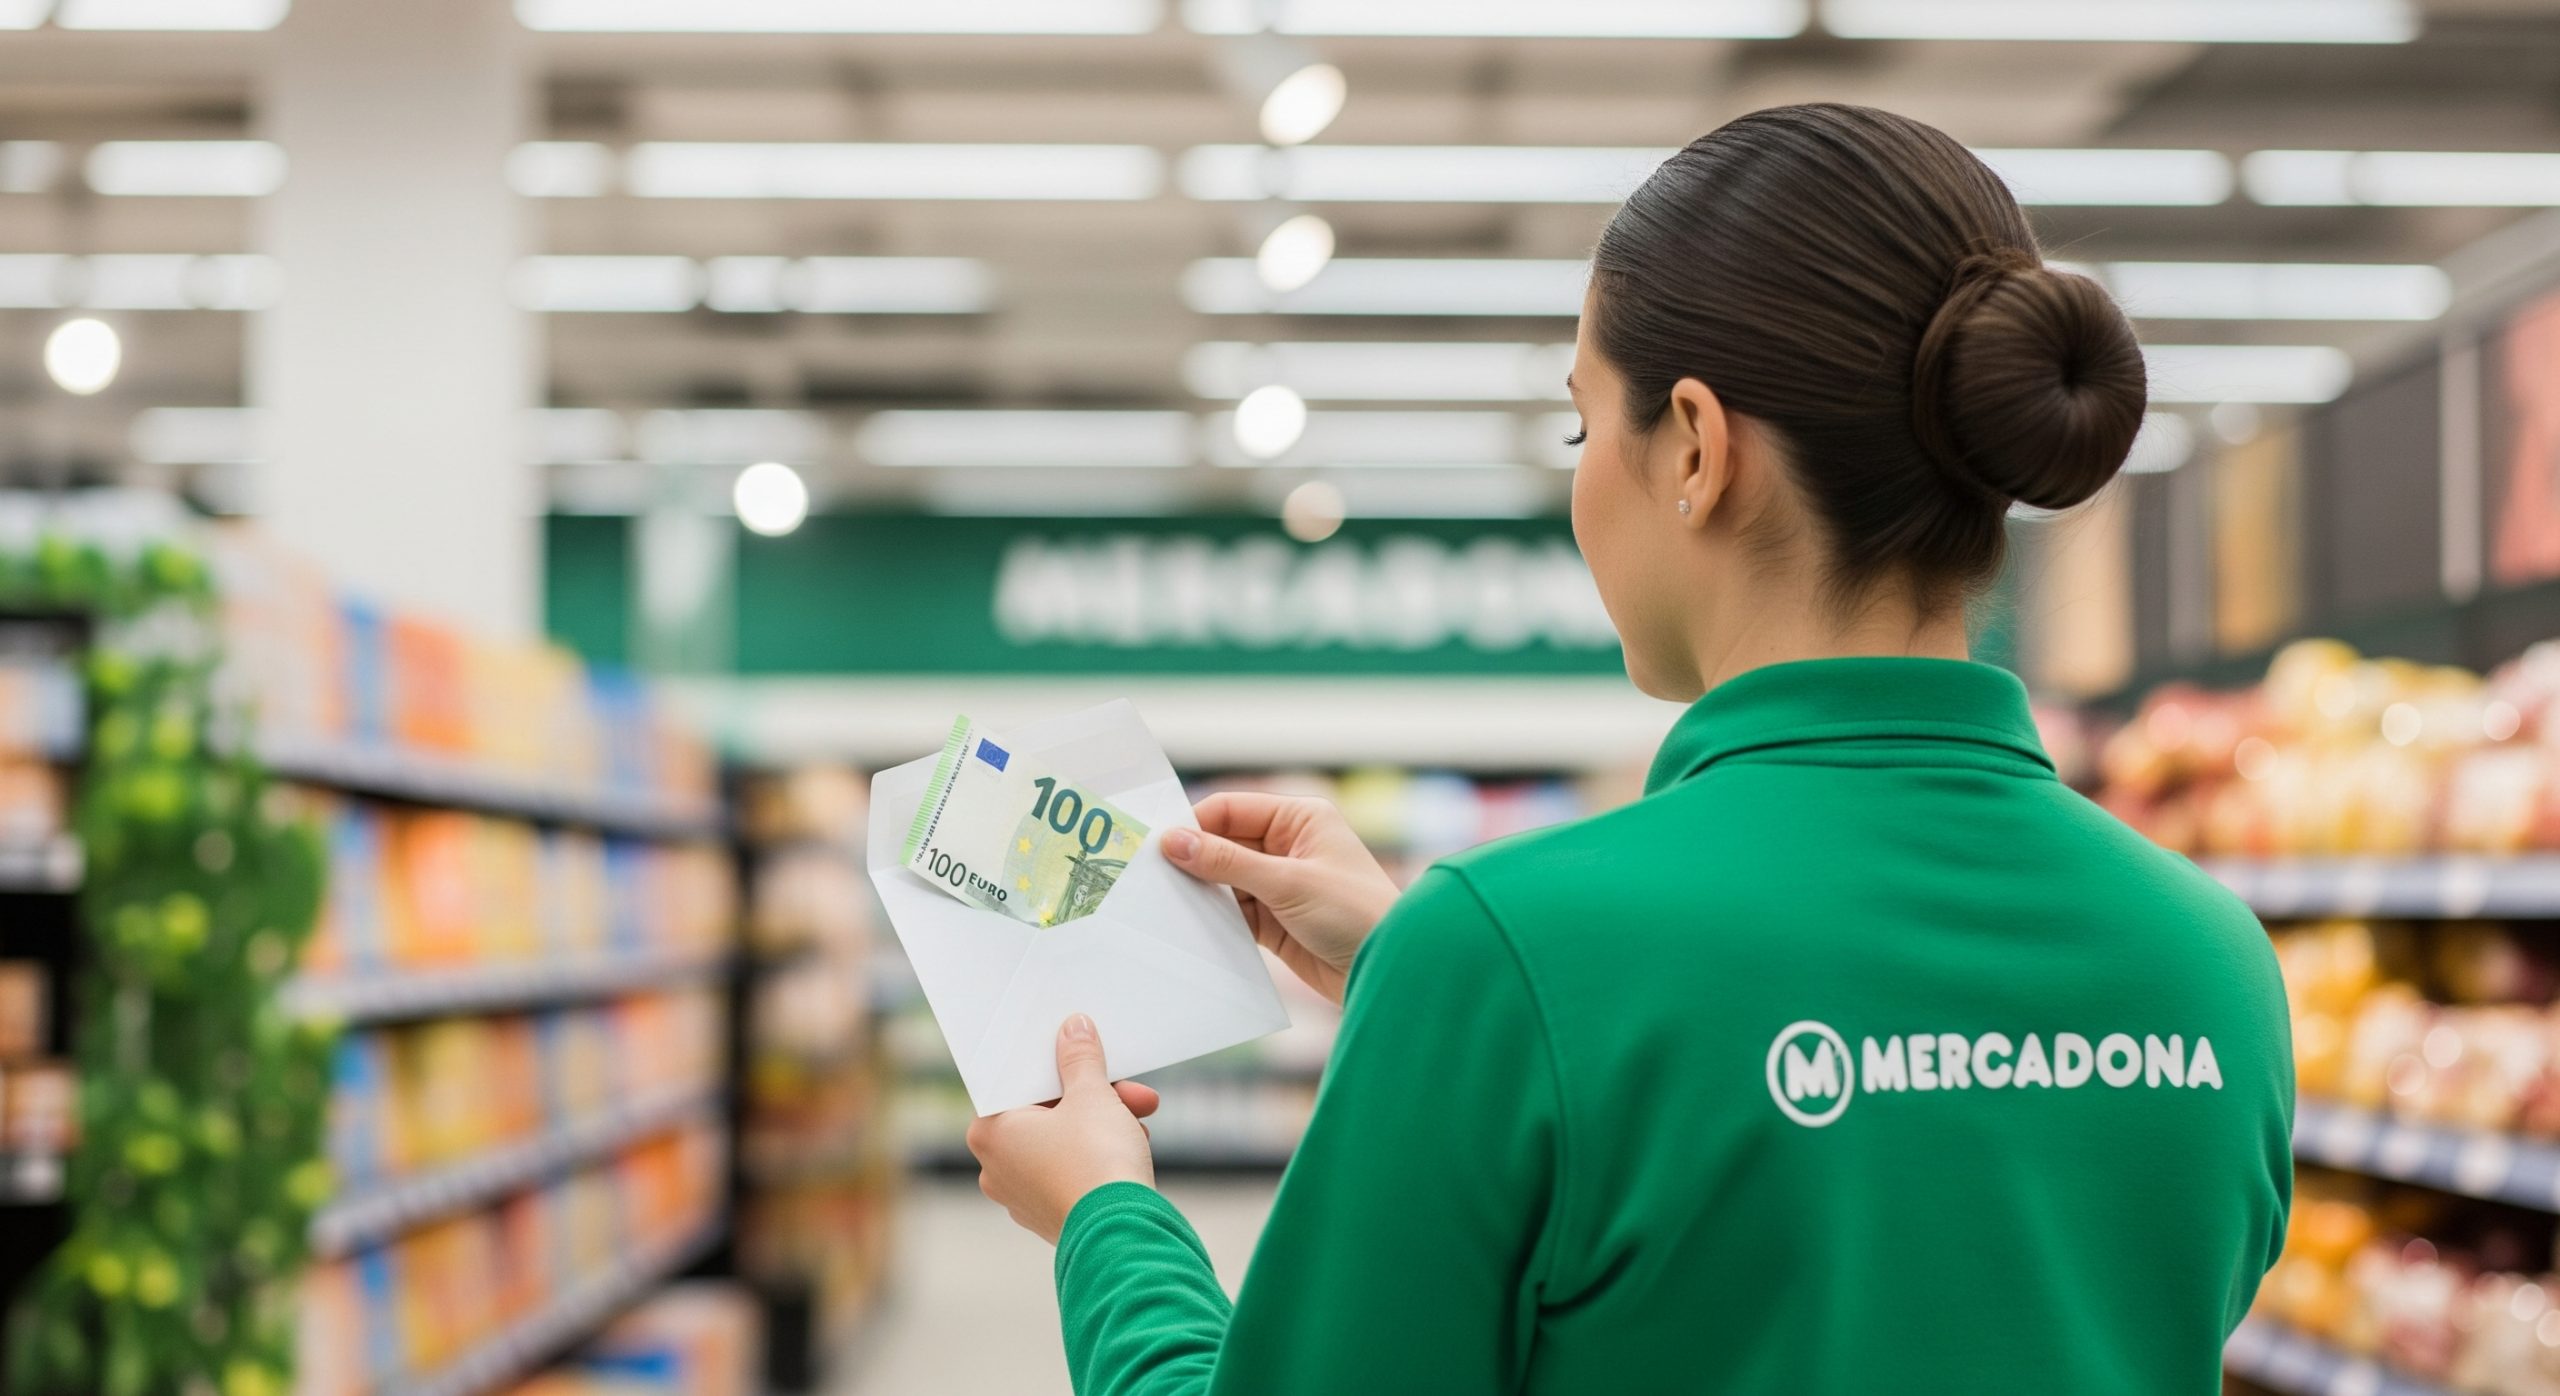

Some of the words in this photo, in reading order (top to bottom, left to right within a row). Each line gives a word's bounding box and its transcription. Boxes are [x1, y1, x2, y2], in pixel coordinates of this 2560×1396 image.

[994, 534, 1620, 649] MERCADON
[1030, 776, 1113, 854] 100
[927, 847, 967, 887] 100
[968, 872, 1008, 902] EURO
[1783, 1038, 1841, 1103] M
[1862, 1032, 2223, 1093] MERCADONA
